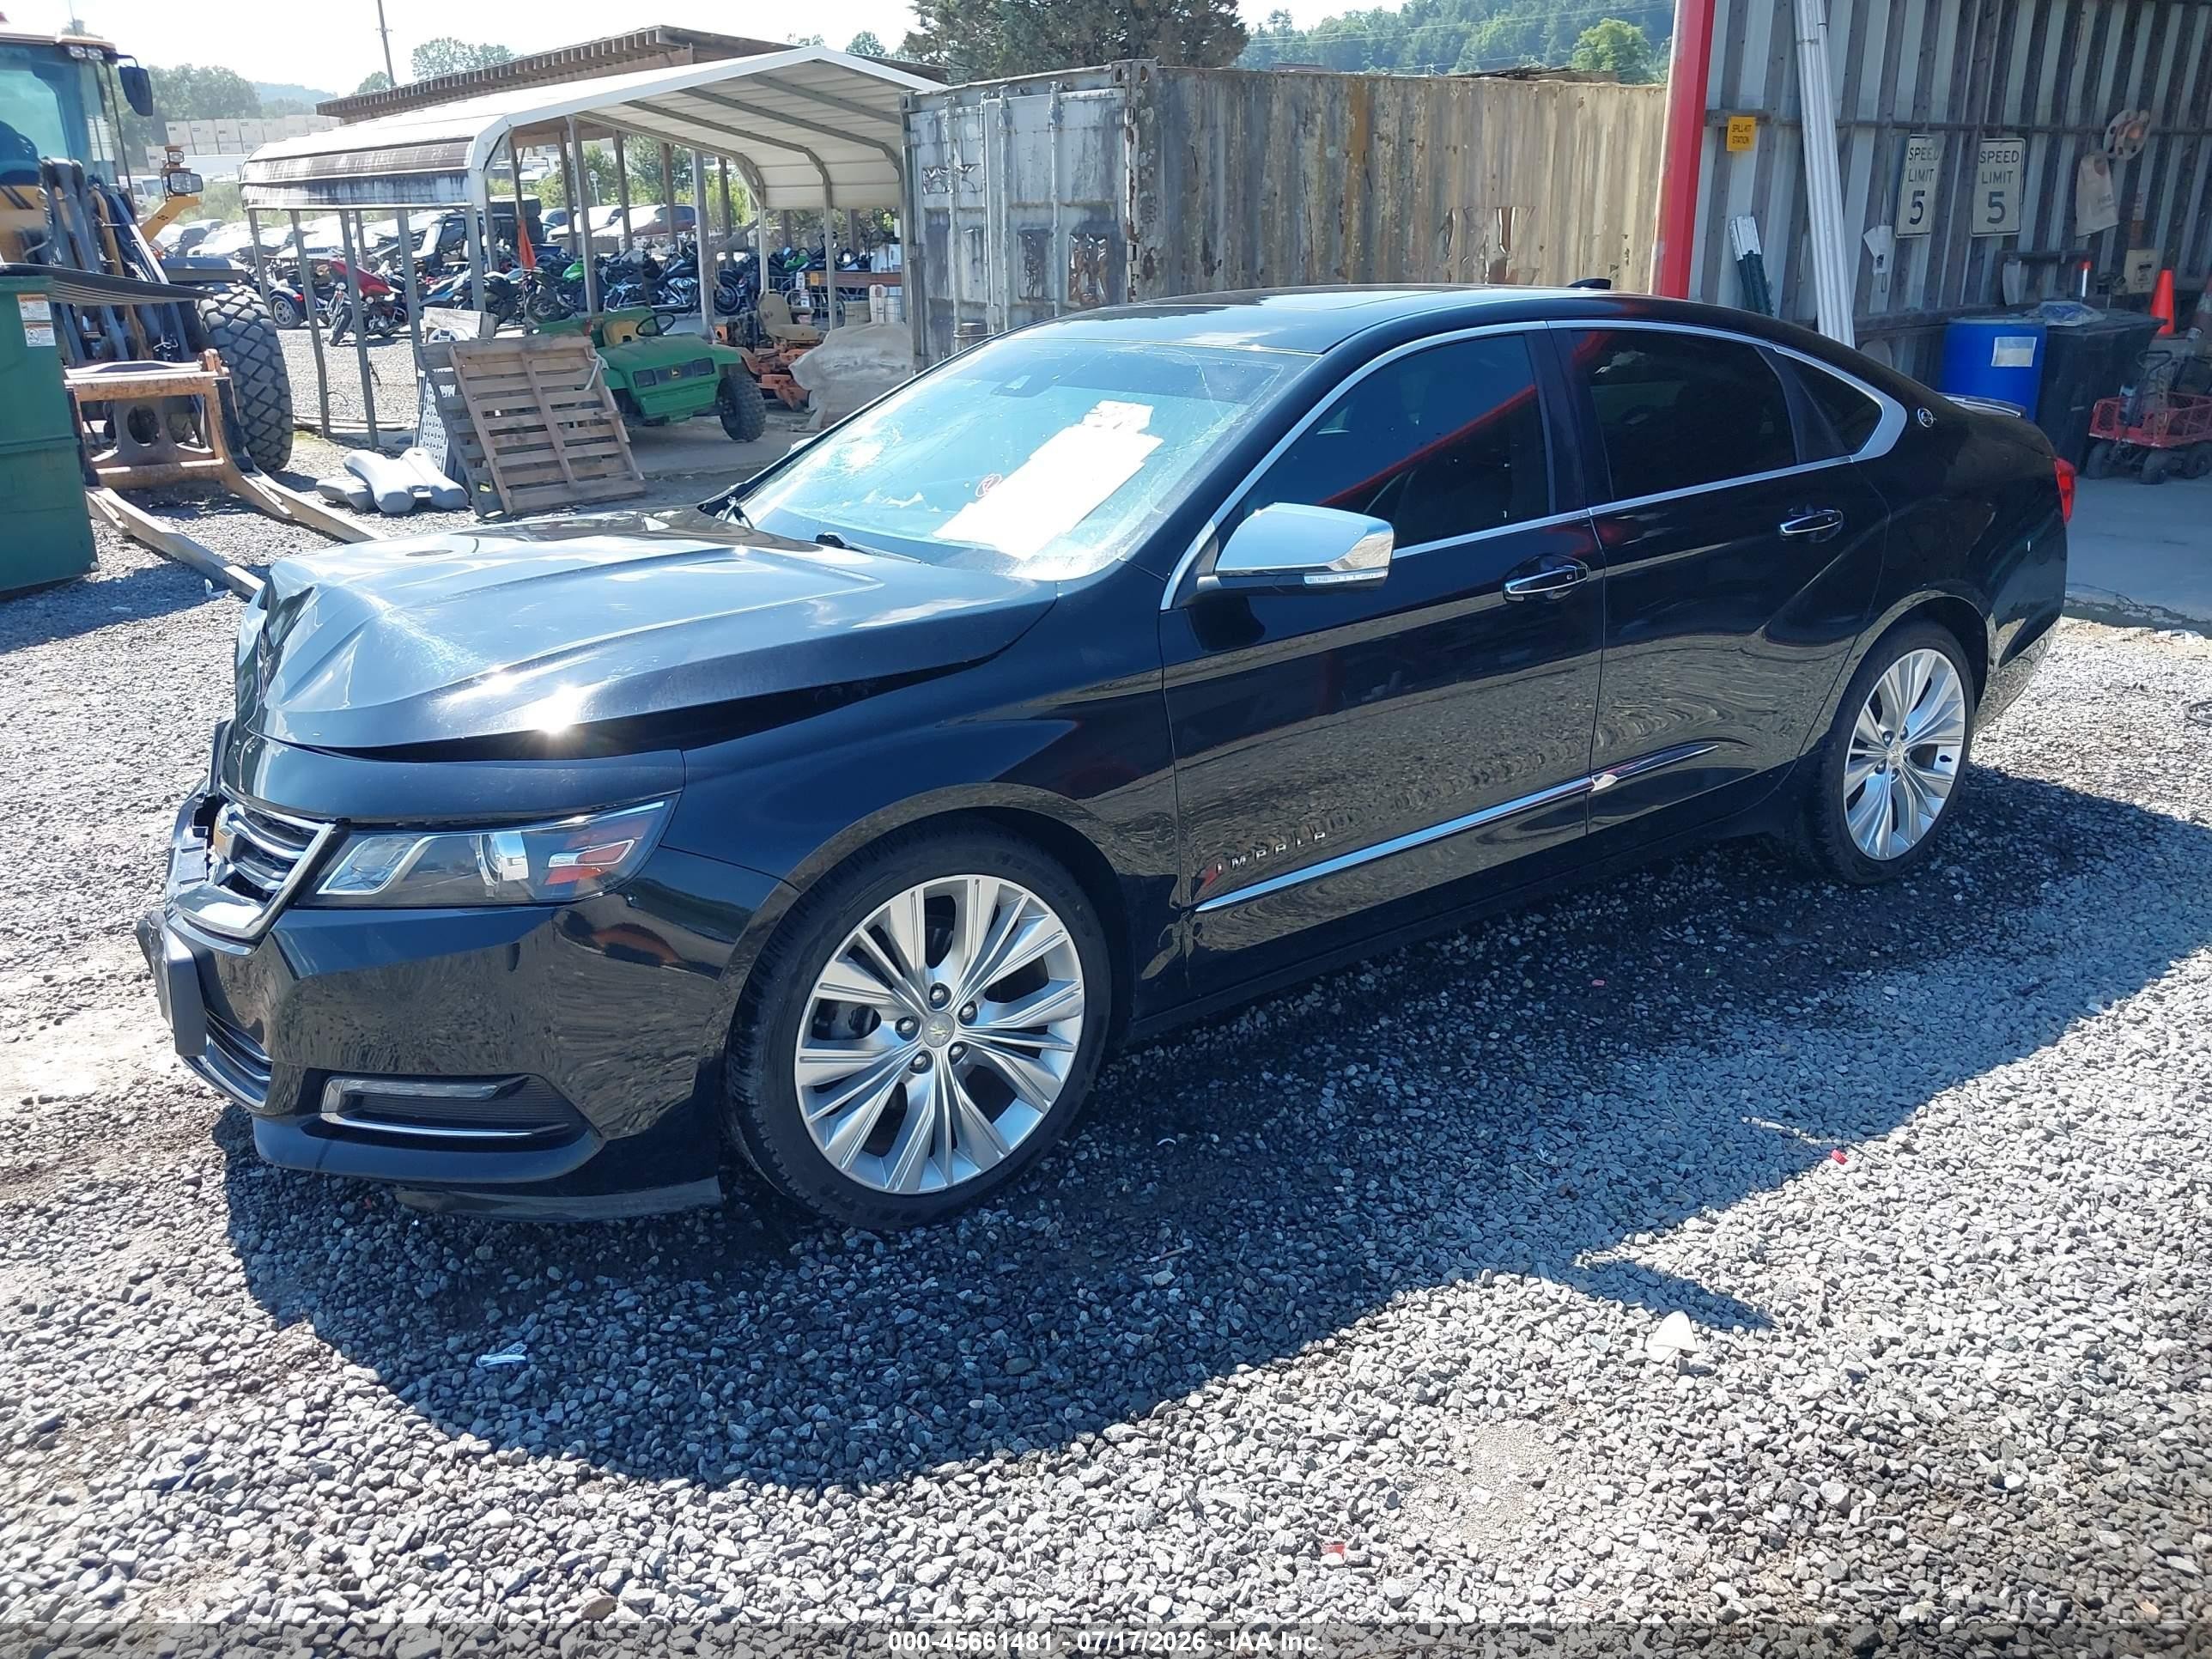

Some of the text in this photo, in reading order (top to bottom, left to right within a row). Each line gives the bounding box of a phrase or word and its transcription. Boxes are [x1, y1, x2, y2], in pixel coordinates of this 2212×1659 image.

[1908, 147, 1940, 161] SPEED
[1978, 150, 2020, 164] SPEED
[1908, 168, 1935, 183] LIMIT
[1981, 171, 2014, 185] LIMIT
[1909, 190, 1926, 225] 5
[1986, 191, 2007, 224] 5
